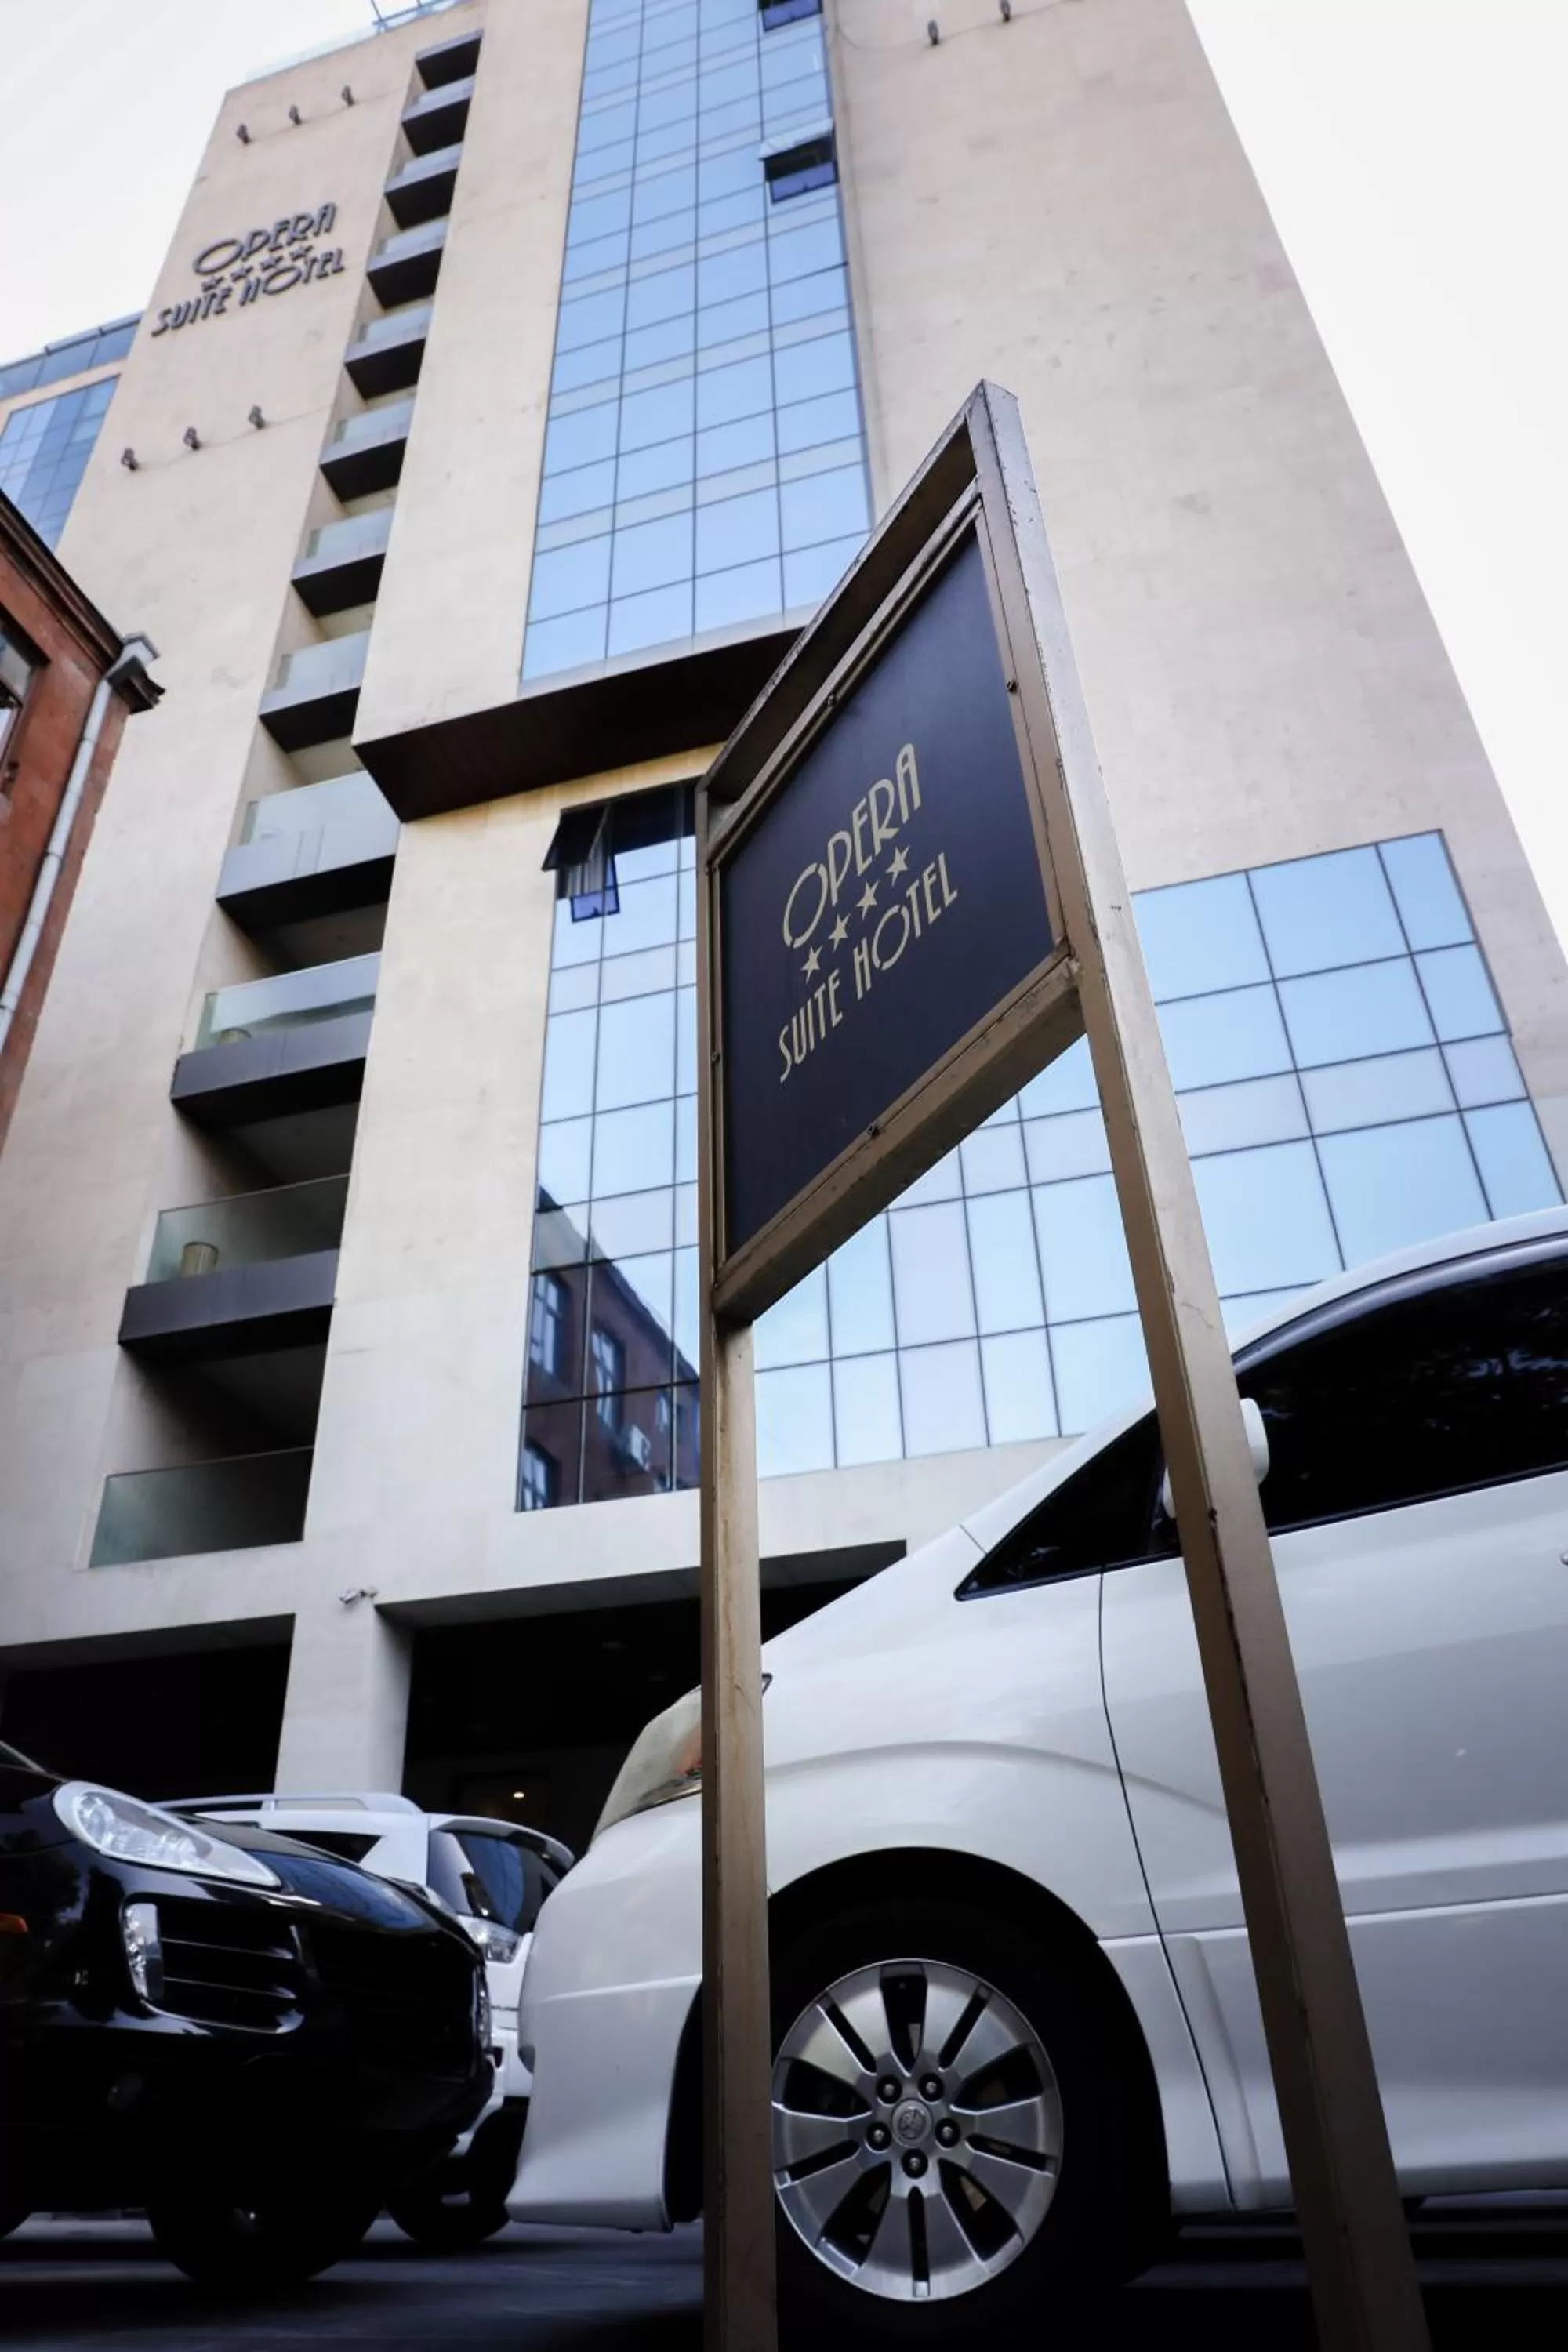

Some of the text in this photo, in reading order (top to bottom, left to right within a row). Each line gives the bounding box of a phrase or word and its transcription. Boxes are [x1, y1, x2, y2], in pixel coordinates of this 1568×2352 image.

[151, 247, 345, 338] SUITE HOTEL
[193, 202, 337, 275] OPERA
[783, 742, 921, 949] OPERA
[778, 852, 958, 1084] SUITE HOTEL
